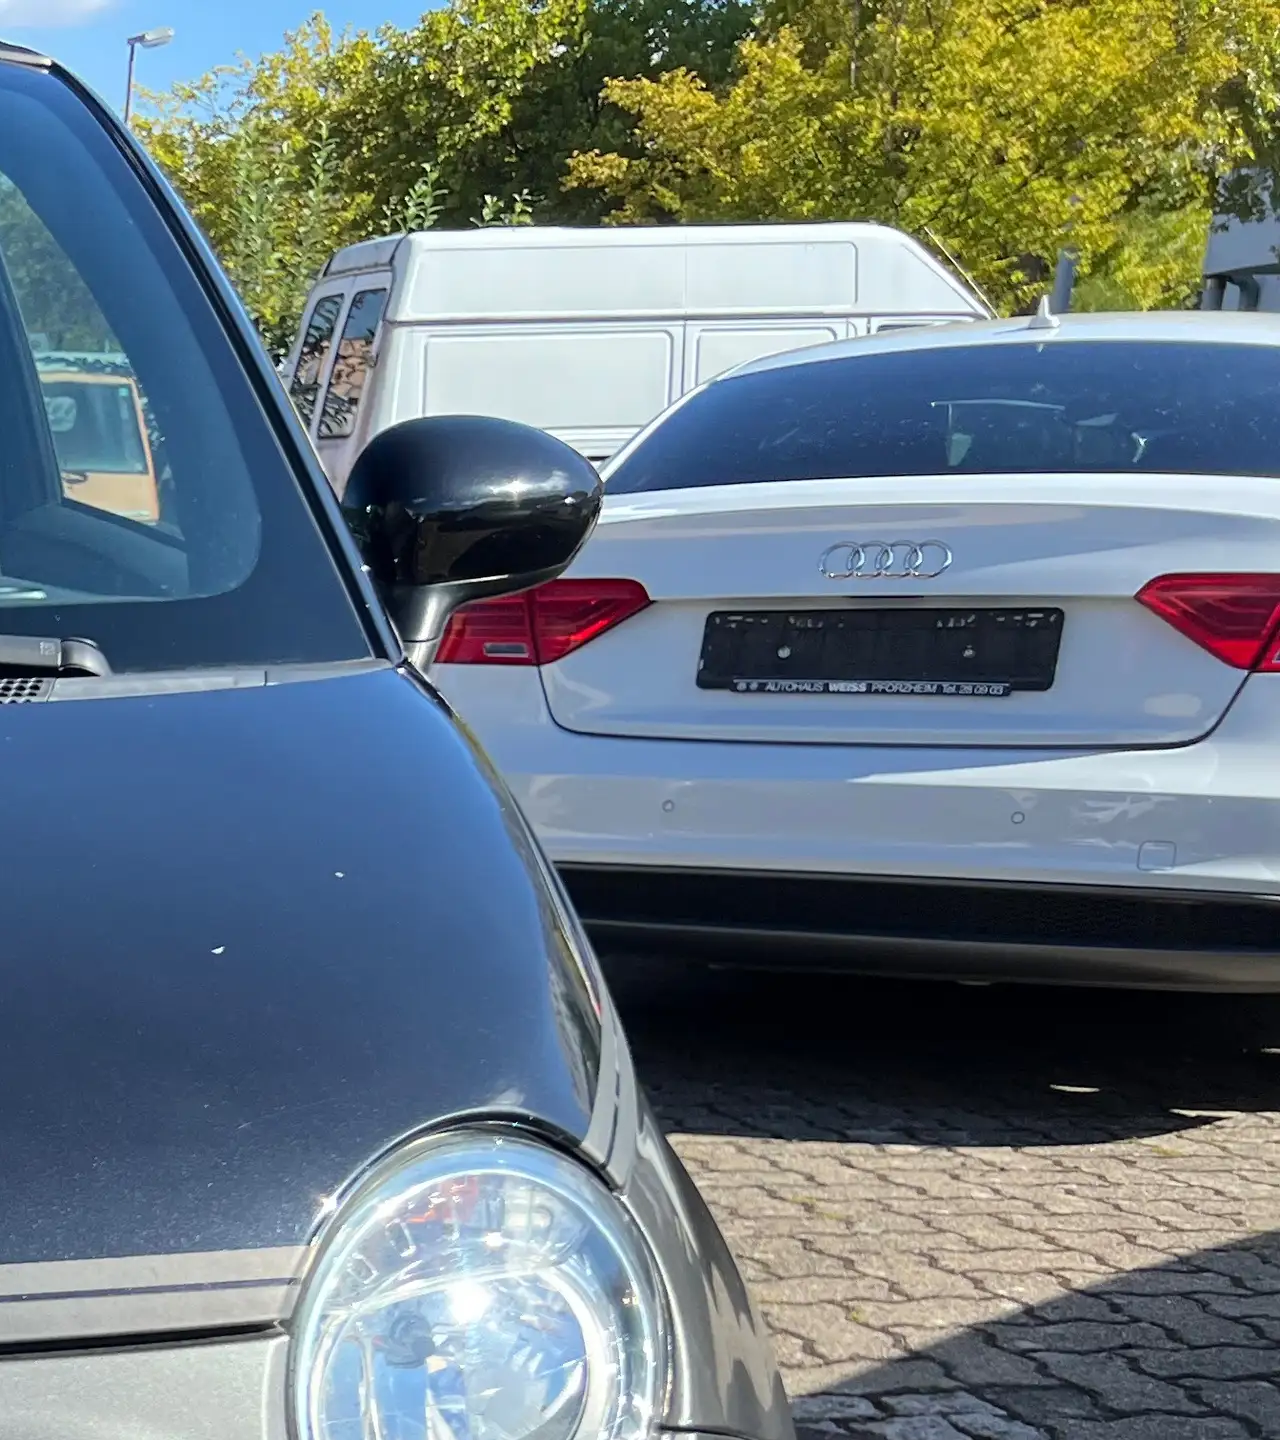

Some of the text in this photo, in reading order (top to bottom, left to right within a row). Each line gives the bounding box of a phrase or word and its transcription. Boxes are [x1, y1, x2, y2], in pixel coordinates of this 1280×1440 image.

[764, 681, 824, 692] AUTOHAUS
[828, 682, 867, 693] WEISS
[871, 682, 938, 693] PFORZHEIM
